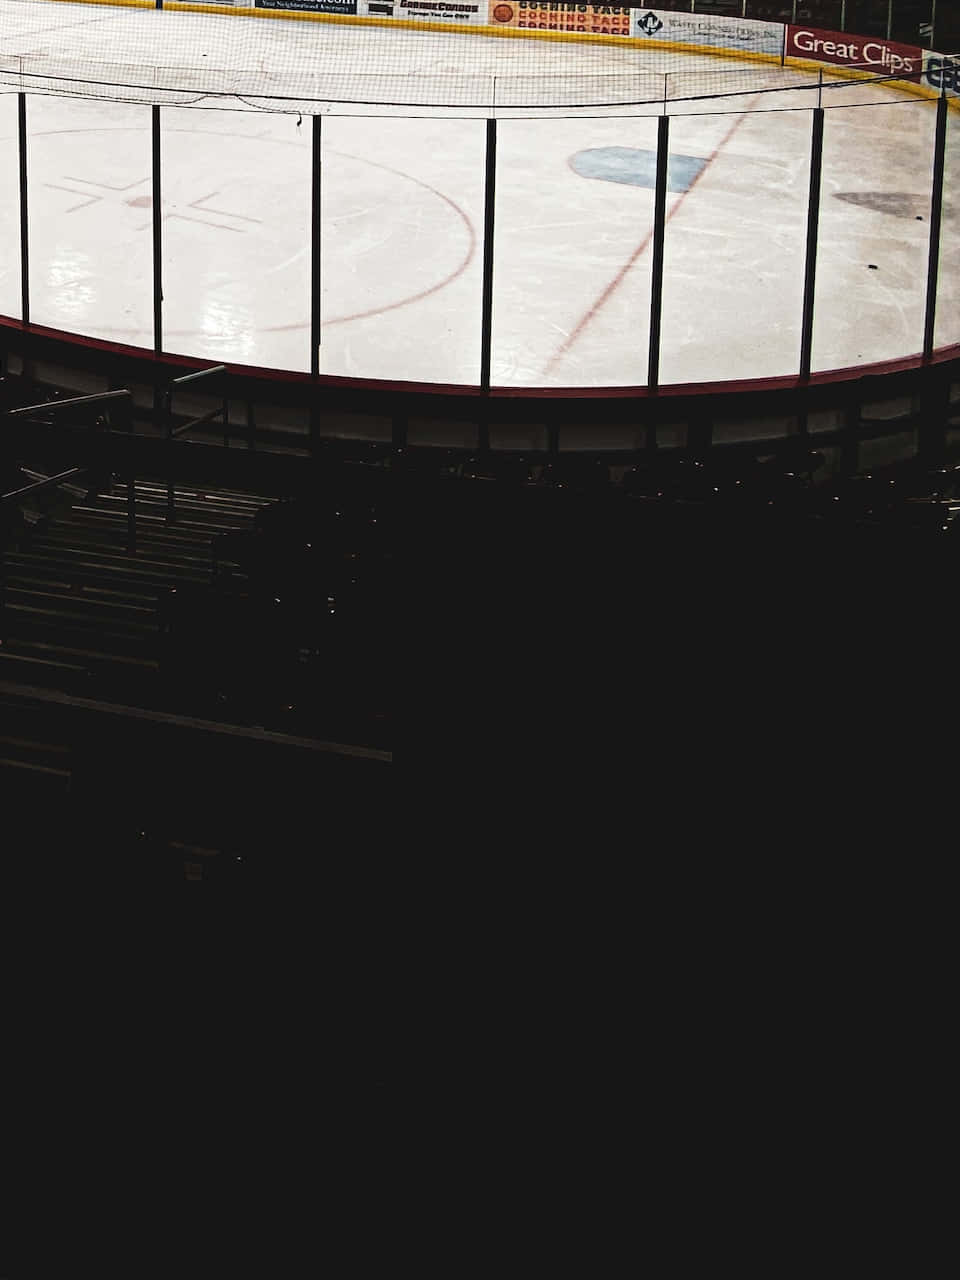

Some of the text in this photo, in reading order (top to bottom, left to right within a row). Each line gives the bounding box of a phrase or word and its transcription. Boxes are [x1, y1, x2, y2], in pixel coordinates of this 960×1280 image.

[519, 10, 631, 25] COCHINO TACO
[793, 31, 858, 60] Great
[862, 43, 913, 74] Clips
